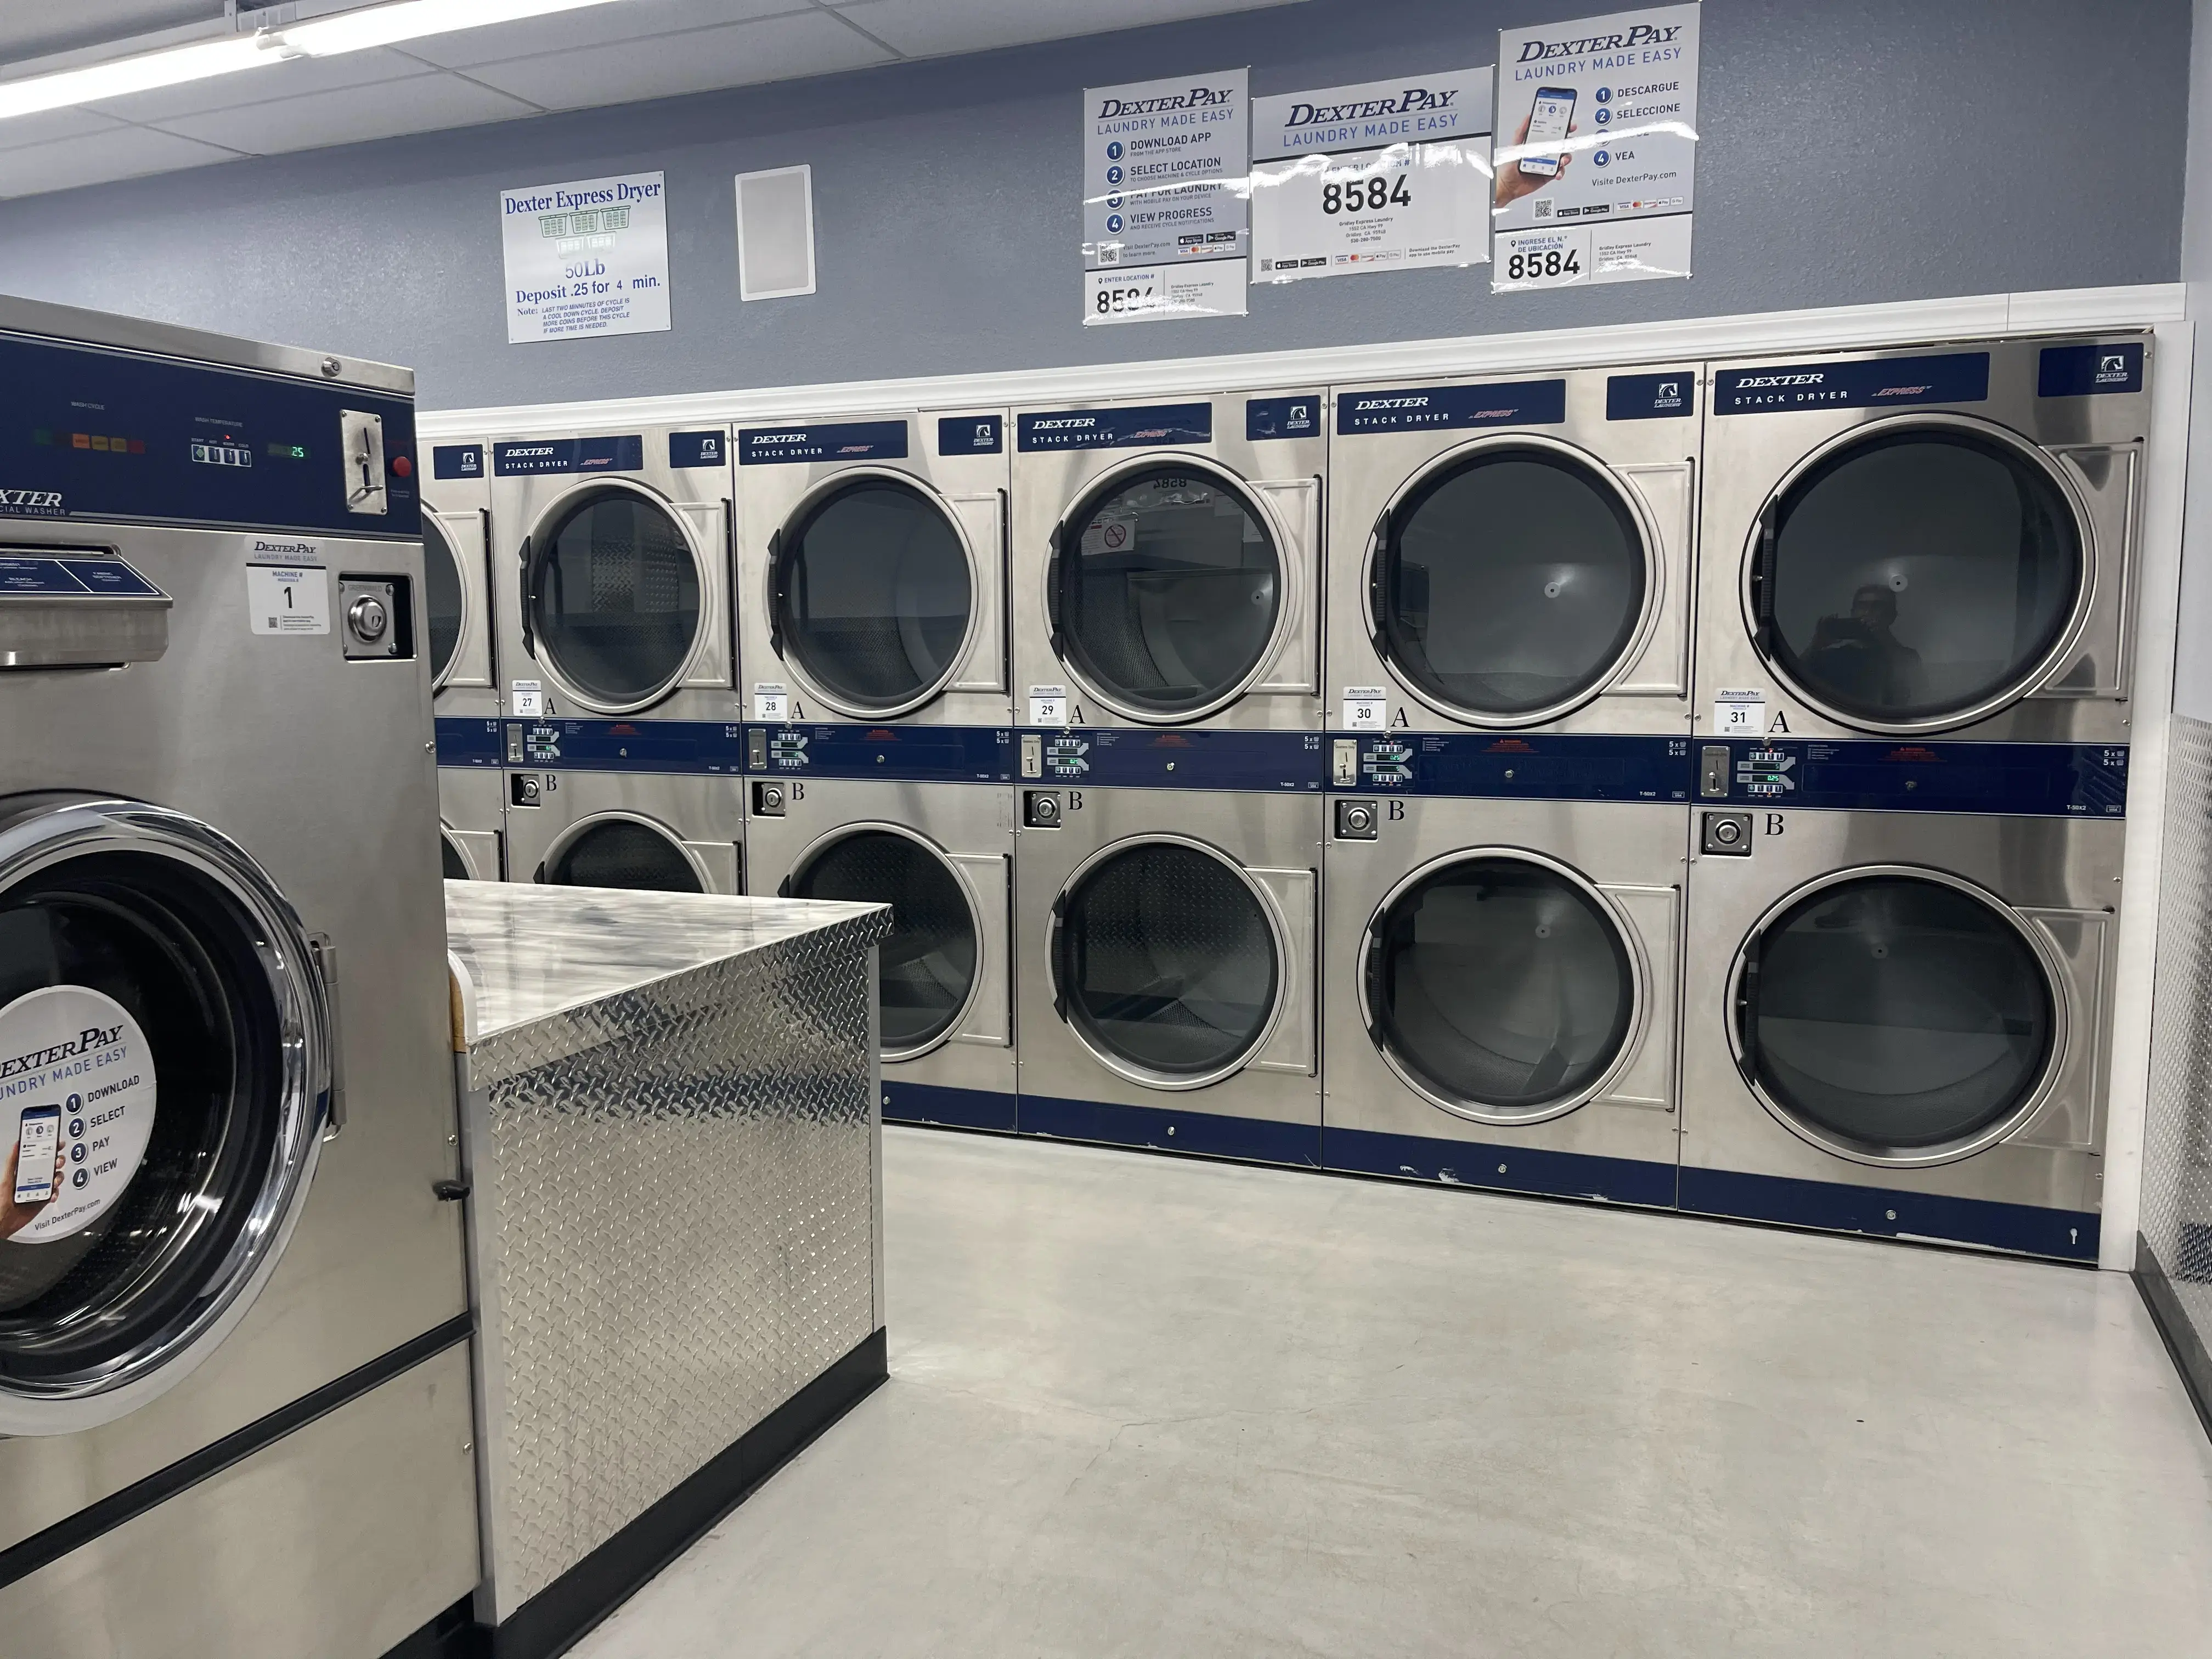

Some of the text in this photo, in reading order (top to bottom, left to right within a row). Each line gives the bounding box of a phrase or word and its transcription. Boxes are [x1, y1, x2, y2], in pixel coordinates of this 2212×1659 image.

[1515, 47, 1681, 81] LAUNDRY MADE EASY
[1601, 82, 1679, 100] 1 DESCARGUE
[1600, 103, 1680, 121] 2 SELECCIONE
[1097, 109, 1234, 135] LAUNDRY MADE EASY
[1284, 114, 1459, 147] LAUNDRY MADE EASY
[1112, 132, 1211, 156] 1 DOWNLOAD APP
[1598, 151, 1635, 163] 4 VEA
[1111, 157, 1221, 180] 2 SELECT LOCATION
[1592, 171, 1677, 187] Visite DexterPay.com
[505, 183, 661, 215] Dexter Express Dryer
[1322, 173, 1412, 215] 8584
[1112, 207, 1212, 229] 4 VIEW PROGRESS
[1178, 218, 1215, 226] NOTIFICATIONS
[1135, 242, 1171, 250] DexterPay.com
[1528, 242, 1563, 252] UBICACIÓN
[565, 258, 605, 279] 50Lb
[1509, 249, 1580, 279] 8584
[516, 275, 661, 304] Deposit .25 for 4 min.
[517, 308, 538, 317] Note:
[1736, 374, 1824, 388] DEXTER
[1735, 391, 1849, 405] STACK DRYER
[1878, 385, 1926, 396] EXPRESS
[1355, 397, 1429, 410] DEXTER
[210, 418, 244, 427] TEMPERATURE
[1355, 413, 1449, 425] STACK DRYER
[1474, 410, 1514, 418] EXPRESS
[1032, 418, 1095, 429] DEXTER
[752, 433, 806, 444] DEXTER
[291, 446, 304, 457] 25
[505, 447, 554, 458] DEXTER
[25, 507, 65, 516] WASHER
[284, 586, 292, 608] 1
[522, 698, 532, 707] 27
[543, 698, 557, 714] A
[766, 702, 776, 711] 28
[791, 701, 806, 719] A
[1042, 706, 1053, 715] 29
[1069, 704, 1086, 724] A
[1357, 708, 1371, 719] 30
[1390, 707, 1410, 727] A
[1730, 712, 1746, 723] 31
[1768, 710, 1792, 733] A
[545, 775, 557, 791] B
[792, 782, 804, 800] B
[1069, 791, 1083, 810] B
[1387, 800, 1404, 821] B
[1764, 814, 1784, 836] B
[0, 1025, 123, 1079] EXTERPAY
[53, 1059, 92, 1082] MADE
[97, 1046, 127, 1067] EASY
[70, 1075, 140, 1109] 1 DOWNLOAD
[72, 1106, 126, 1134] 2 SELECT
[75, 1136, 110, 1159] 3 PAY
[76, 1158, 119, 1184] 4 VIEW
[35, 1199, 100, 1231] Visit DexterPay.com
